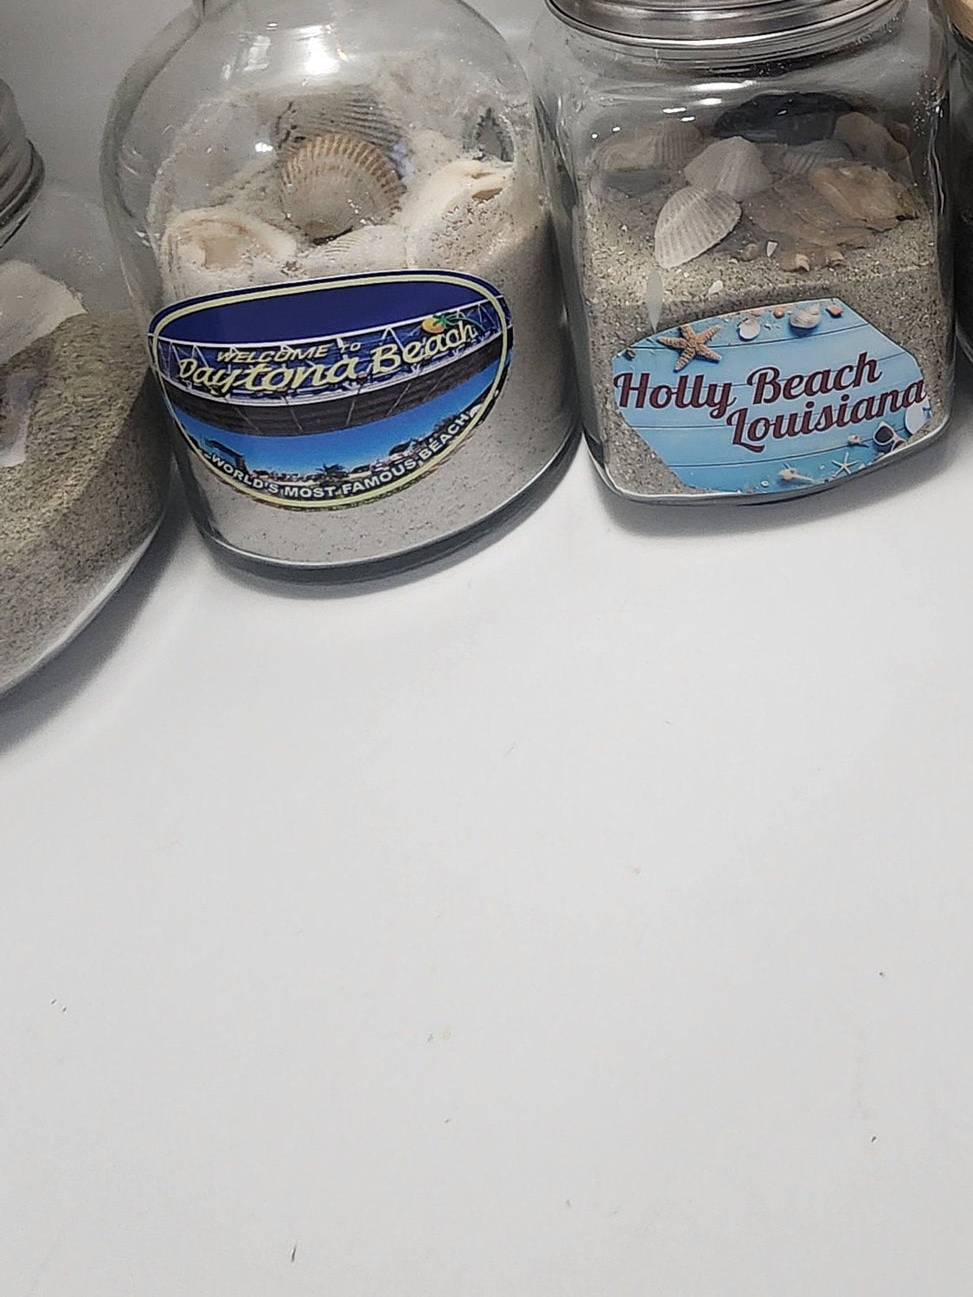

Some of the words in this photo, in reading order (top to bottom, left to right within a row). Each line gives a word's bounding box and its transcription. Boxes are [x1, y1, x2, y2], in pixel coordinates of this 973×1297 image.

[178, 355, 359, 397] Daytona
[371, 319, 477, 376] Beach
[216, 344, 329, 364] WELCOME
[612, 373, 736, 419] Holly
[746, 351, 883, 405] Beach
[725, 379, 928, 453] Louisiana
[209, 452, 280, 495] WORLD'S
[283, 483, 338, 499] MOST
[341, 458, 418, 496] FAMOUS
[417, 411, 473, 463] BEACH
